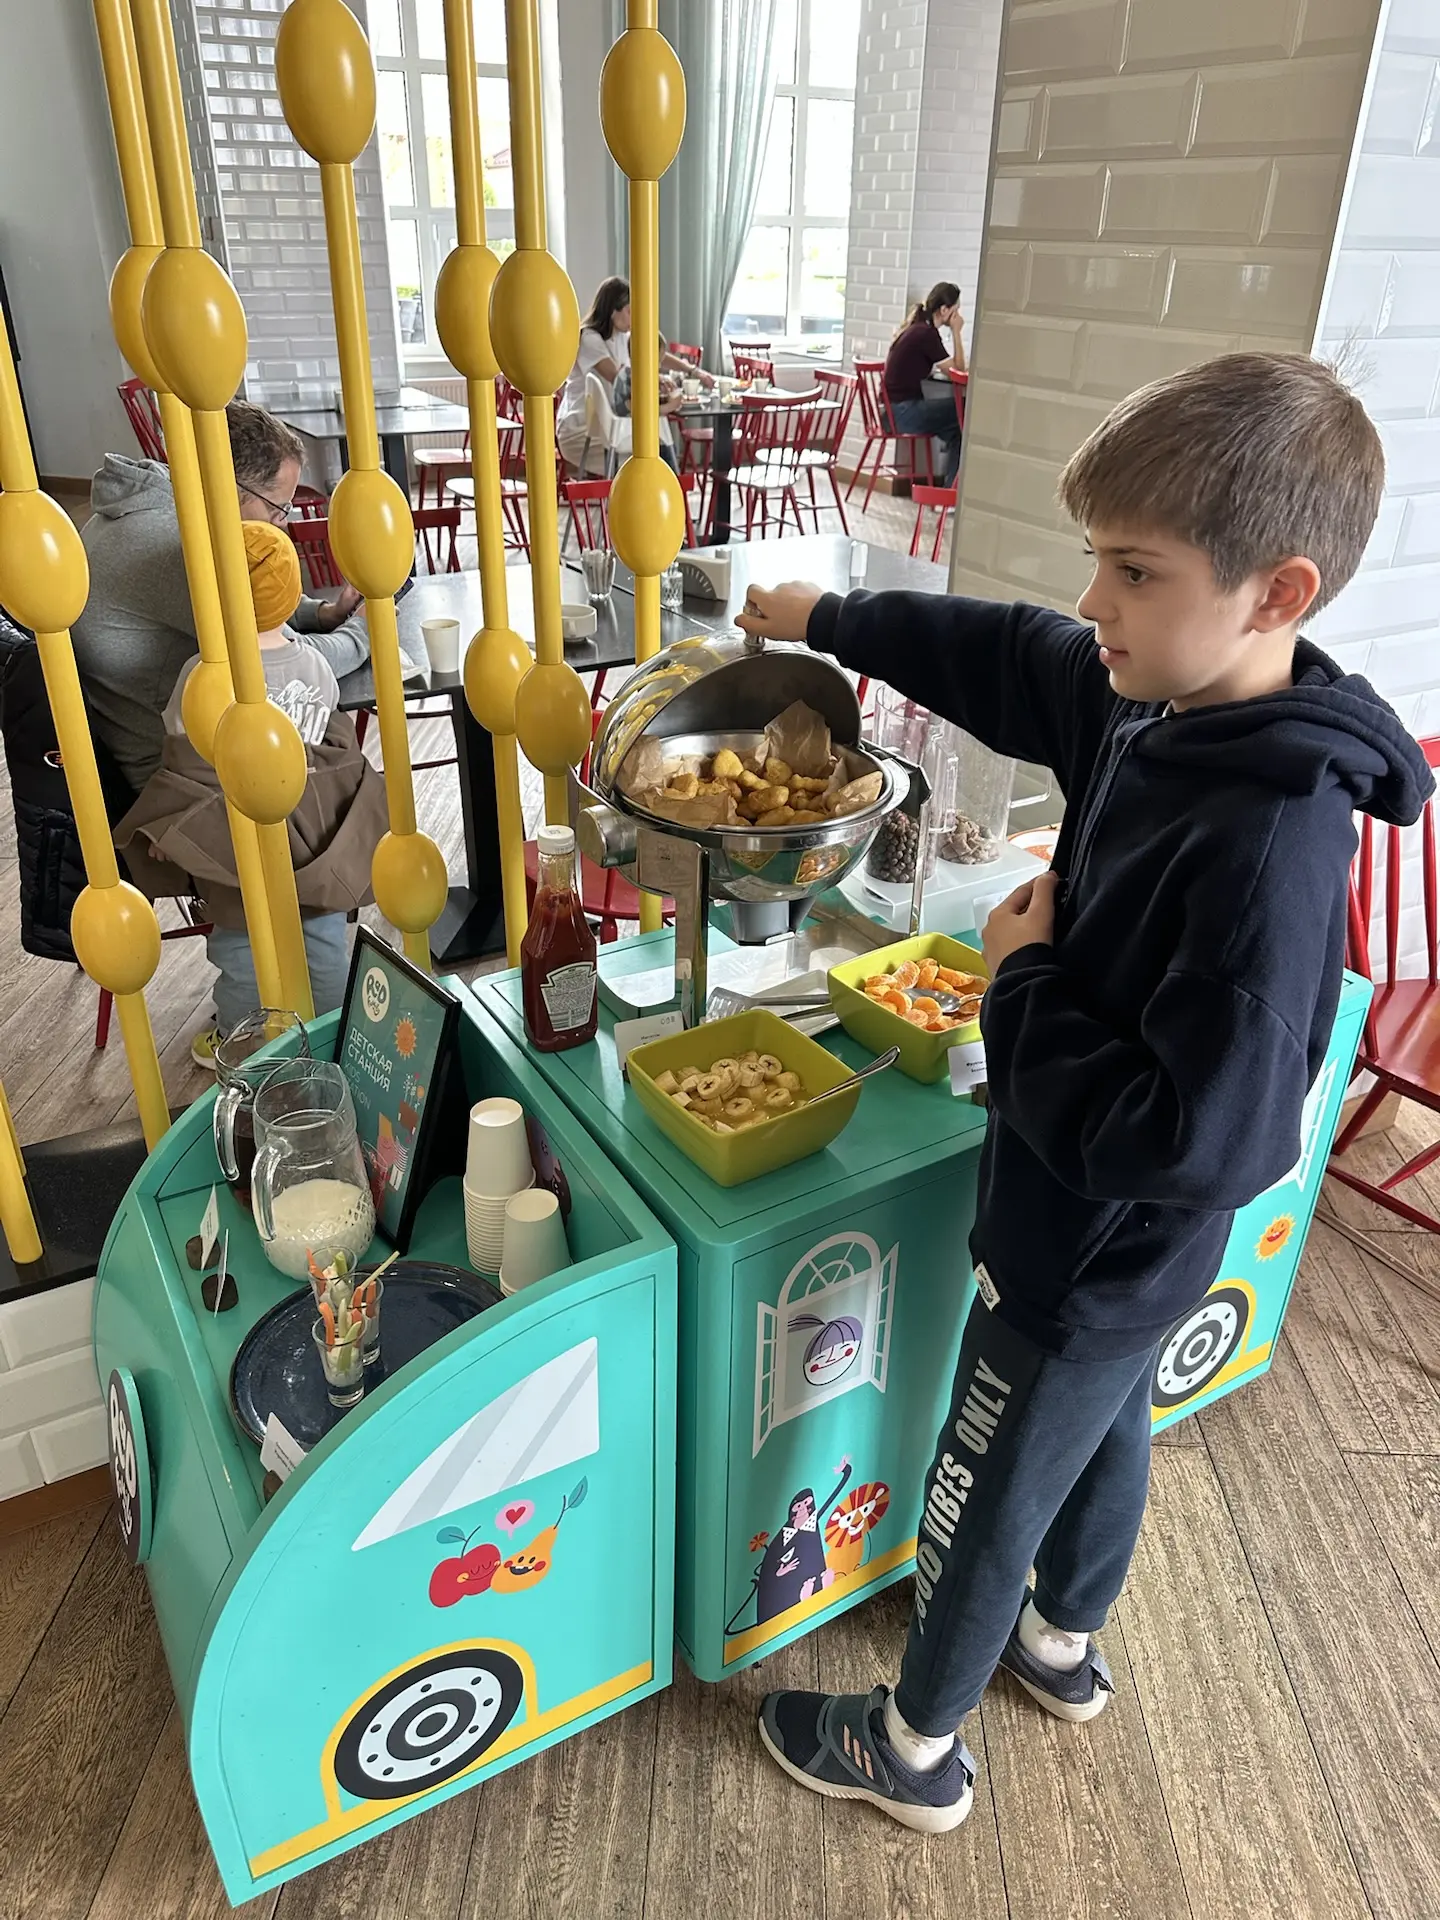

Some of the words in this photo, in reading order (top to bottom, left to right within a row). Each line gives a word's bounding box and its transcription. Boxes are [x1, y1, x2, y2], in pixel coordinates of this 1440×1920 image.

[347, 1043, 391, 1092] СТАНЦИЯ
[349, 1027, 393, 1074] ДЕТСКАЯ
[955, 1356, 1012, 1455] ONLY
[924, 1453, 974, 1549] VIBES
[915, 1542, 943, 1635] OOD
